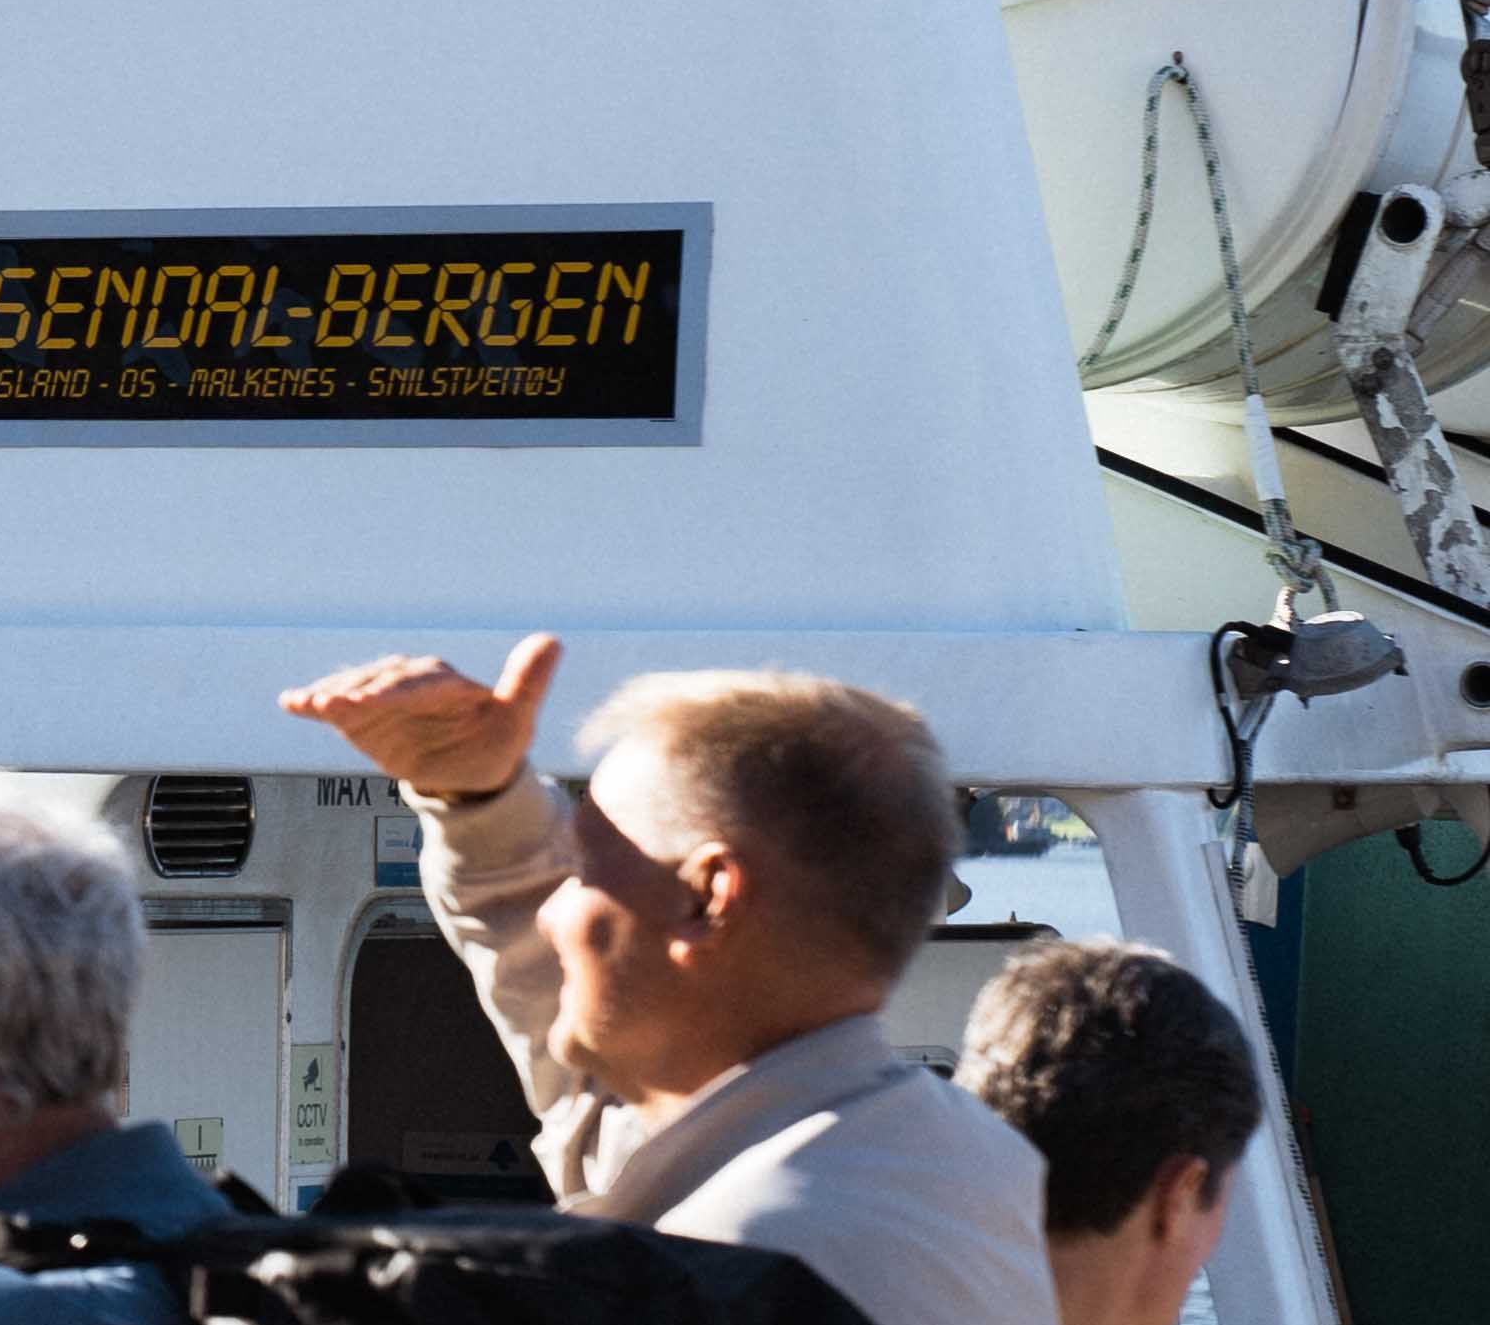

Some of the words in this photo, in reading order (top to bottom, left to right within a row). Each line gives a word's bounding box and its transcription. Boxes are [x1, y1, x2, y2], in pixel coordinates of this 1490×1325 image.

[118, 368, 157, 398] OS
[187, 367, 336, 398] MALKENES
[297, 1103, 328, 1127] CCTV
